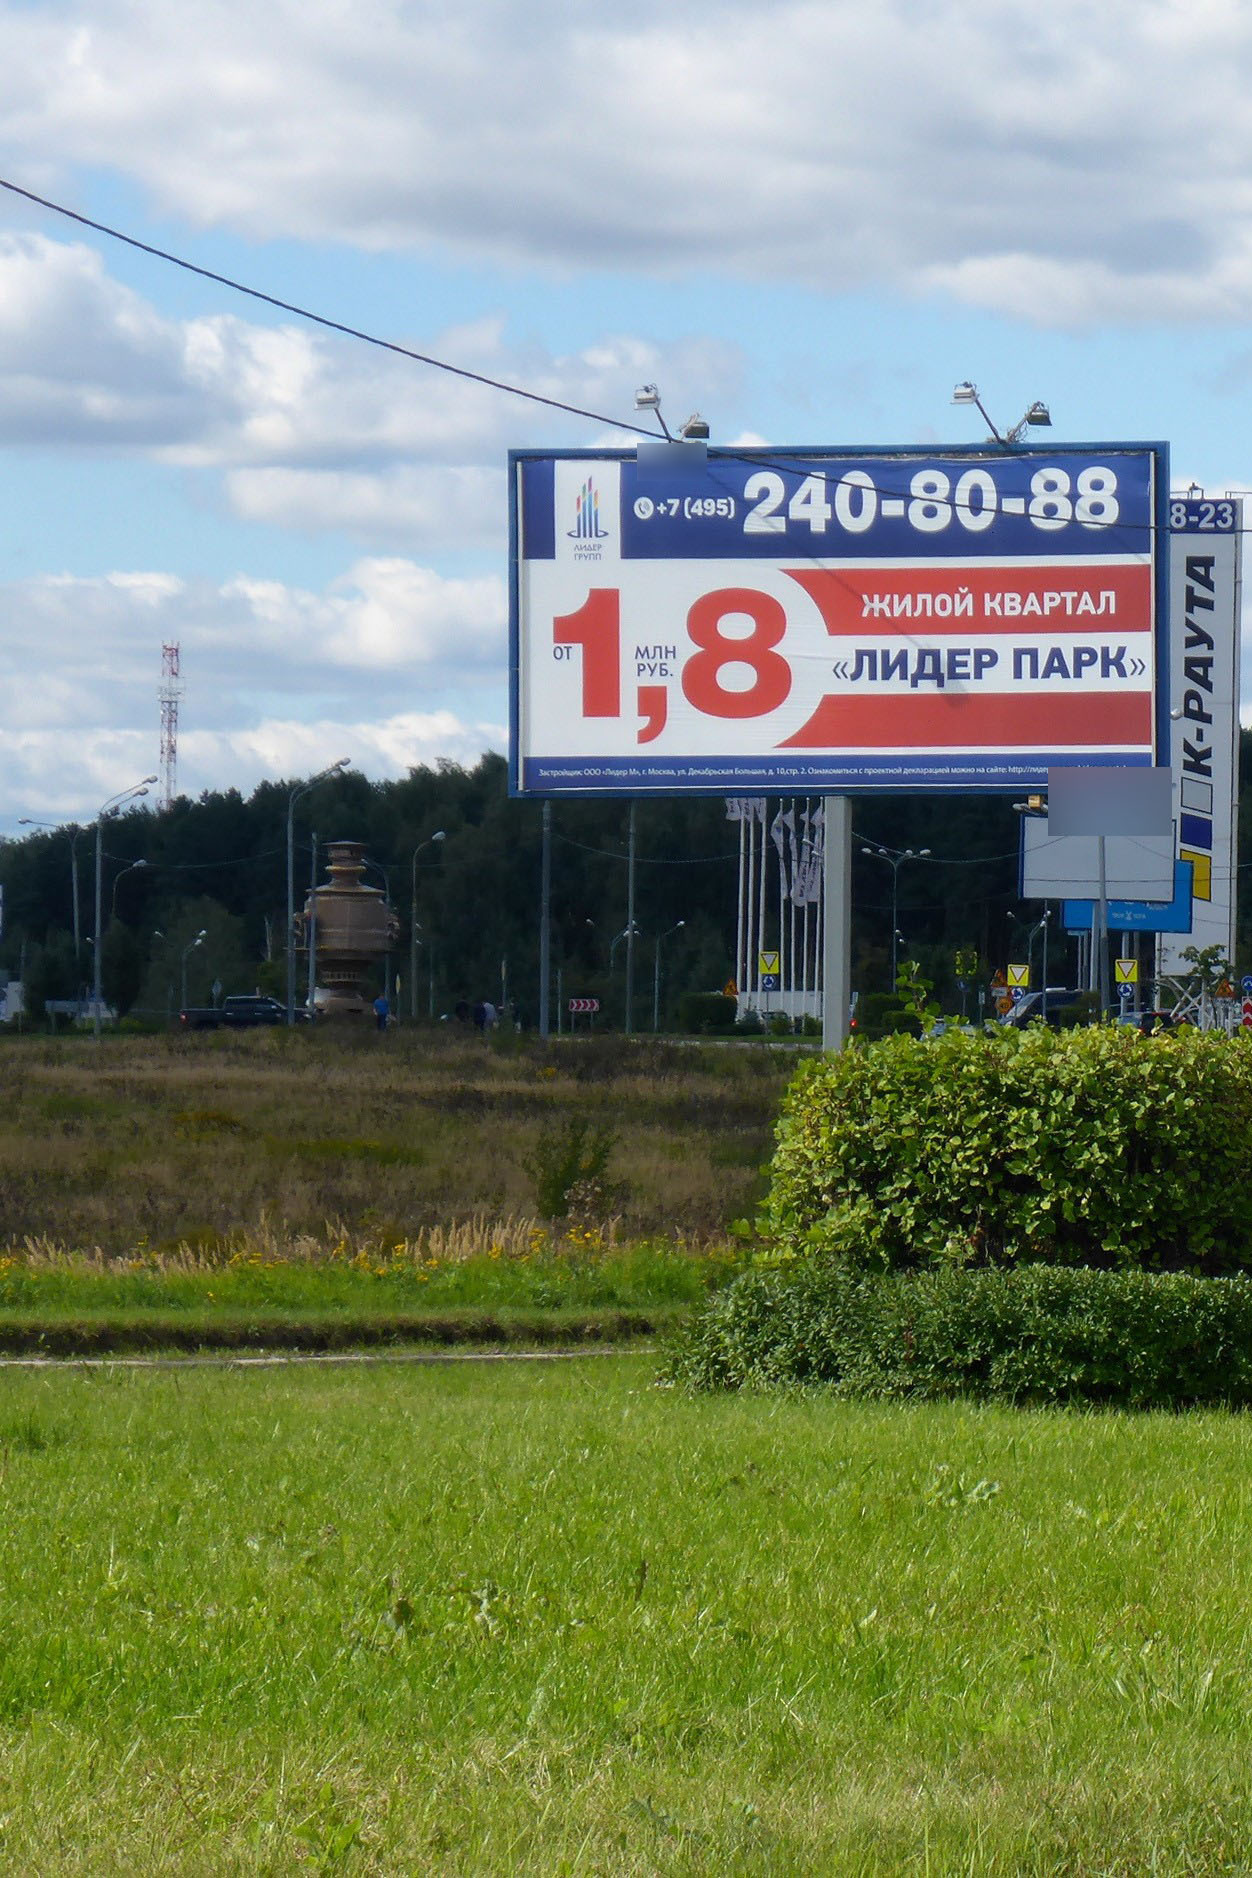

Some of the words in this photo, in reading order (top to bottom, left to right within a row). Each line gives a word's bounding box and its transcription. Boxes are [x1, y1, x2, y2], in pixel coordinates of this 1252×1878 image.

[657, 499, 680, 516] +7
[684, 497, 735, 519] (495)
[743, 467, 1120, 534] 240-80-88
[1170, 502, 1233, 528] 8-23
[574, 544, 602, 552] ЛИДЕР
[862, 587, 974, 617] ЖИЛОЙ
[984, 590, 1116, 616] КВАРТАЛ
[553, 646, 573, 660] ОТ
[635, 645, 677, 660] МЛН
[637, 662, 674, 677] РУБ.
[832, 647, 999, 688] «ЛИДЕР
[1012, 646, 1146, 681] ПАРК»
[1182, 555, 1215, 778] К-РАУТА
[584, 768, 601, 776] ООО
[864, 767, 902, 776] проектной
[903, 766, 950, 775] декларацией
[951, 767, 975, 775] можно
[976, 767, 985, 775] на
